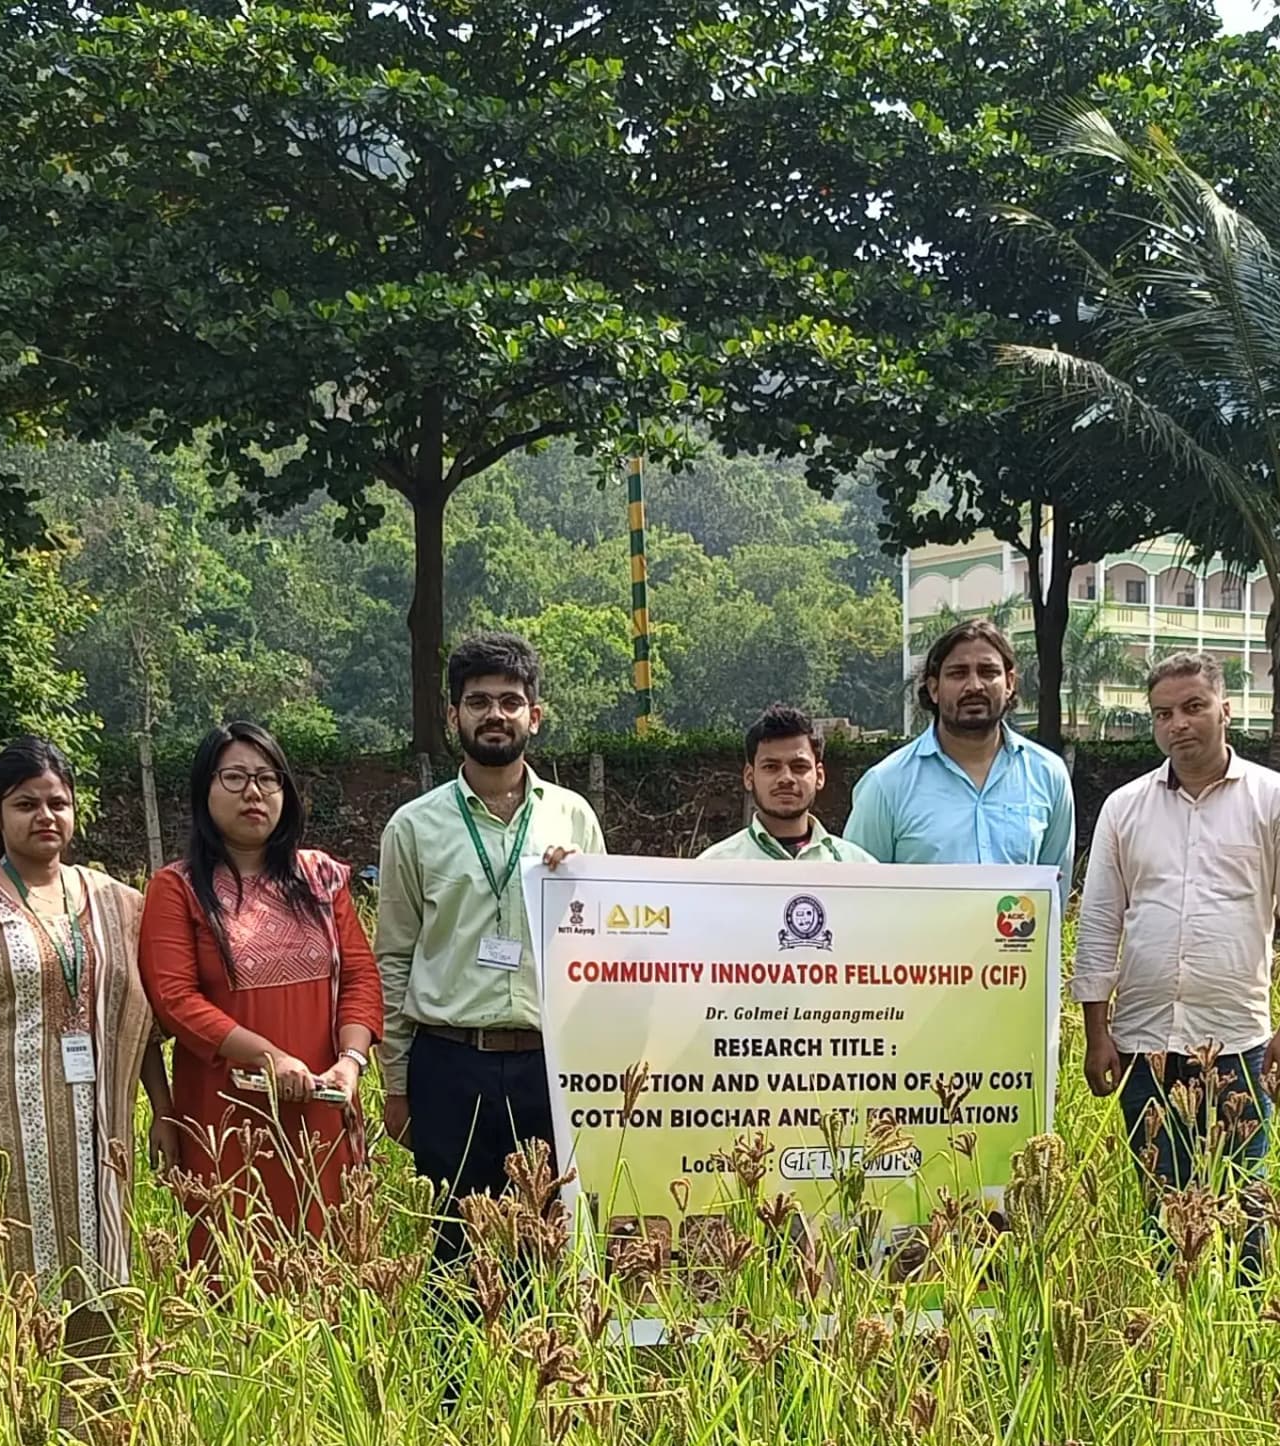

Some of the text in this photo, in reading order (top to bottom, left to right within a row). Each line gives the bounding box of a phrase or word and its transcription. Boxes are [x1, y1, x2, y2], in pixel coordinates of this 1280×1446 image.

[567, 961, 1027, 990] COMMUNITY INNOVATOR FELLOWSHIP (CIF)
[705, 1006, 905, 1024] Dr. Golmei Langangmeilu
[714, 1038, 822, 1058] RESEARCH
[830, 1038, 885, 1057] TITLE
[558, 1072, 1032, 1092] PRODTION AND VALIDATION OF OW COST
[571, 1109, 662, 1128] COTTON
[670, 1108, 770, 1128] BIOCHAR
[778, 1108, 820, 1126] AND
[832, 1108, 858, 1126] TS
